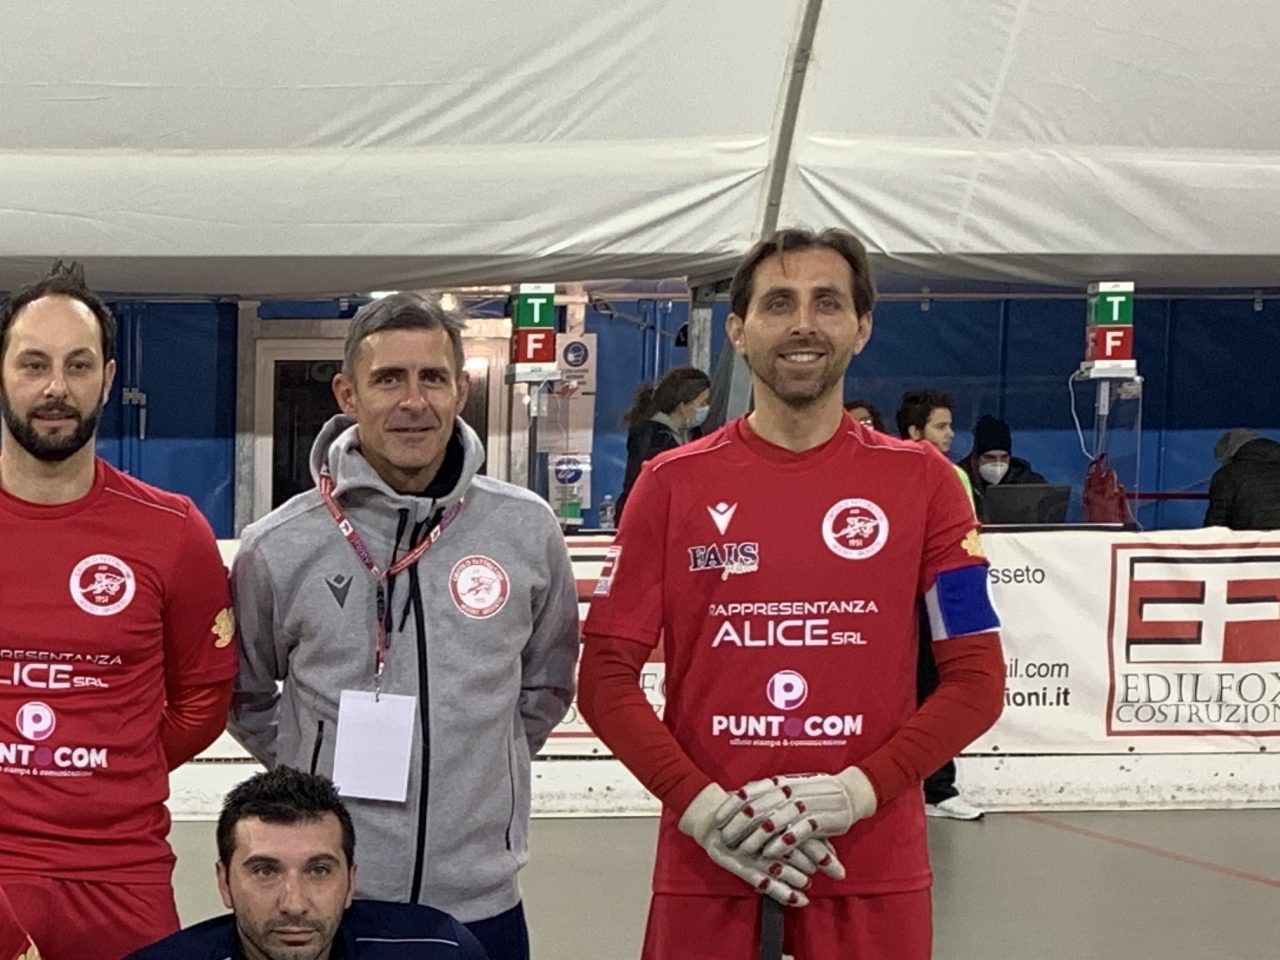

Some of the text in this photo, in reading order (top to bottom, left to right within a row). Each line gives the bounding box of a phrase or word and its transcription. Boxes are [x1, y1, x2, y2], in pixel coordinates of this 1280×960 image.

[527, 298, 547, 323] T
[1106, 296, 1126, 321] T
[527, 334, 545, 359] F
[1105, 331, 1124, 356] F
[988, 565, 1045, 584] sseto
[711, 619, 867, 647] ALICE SRL
[1005, 658, 1069, 678] il.com
[1004, 687, 1070, 706] ioni.it
